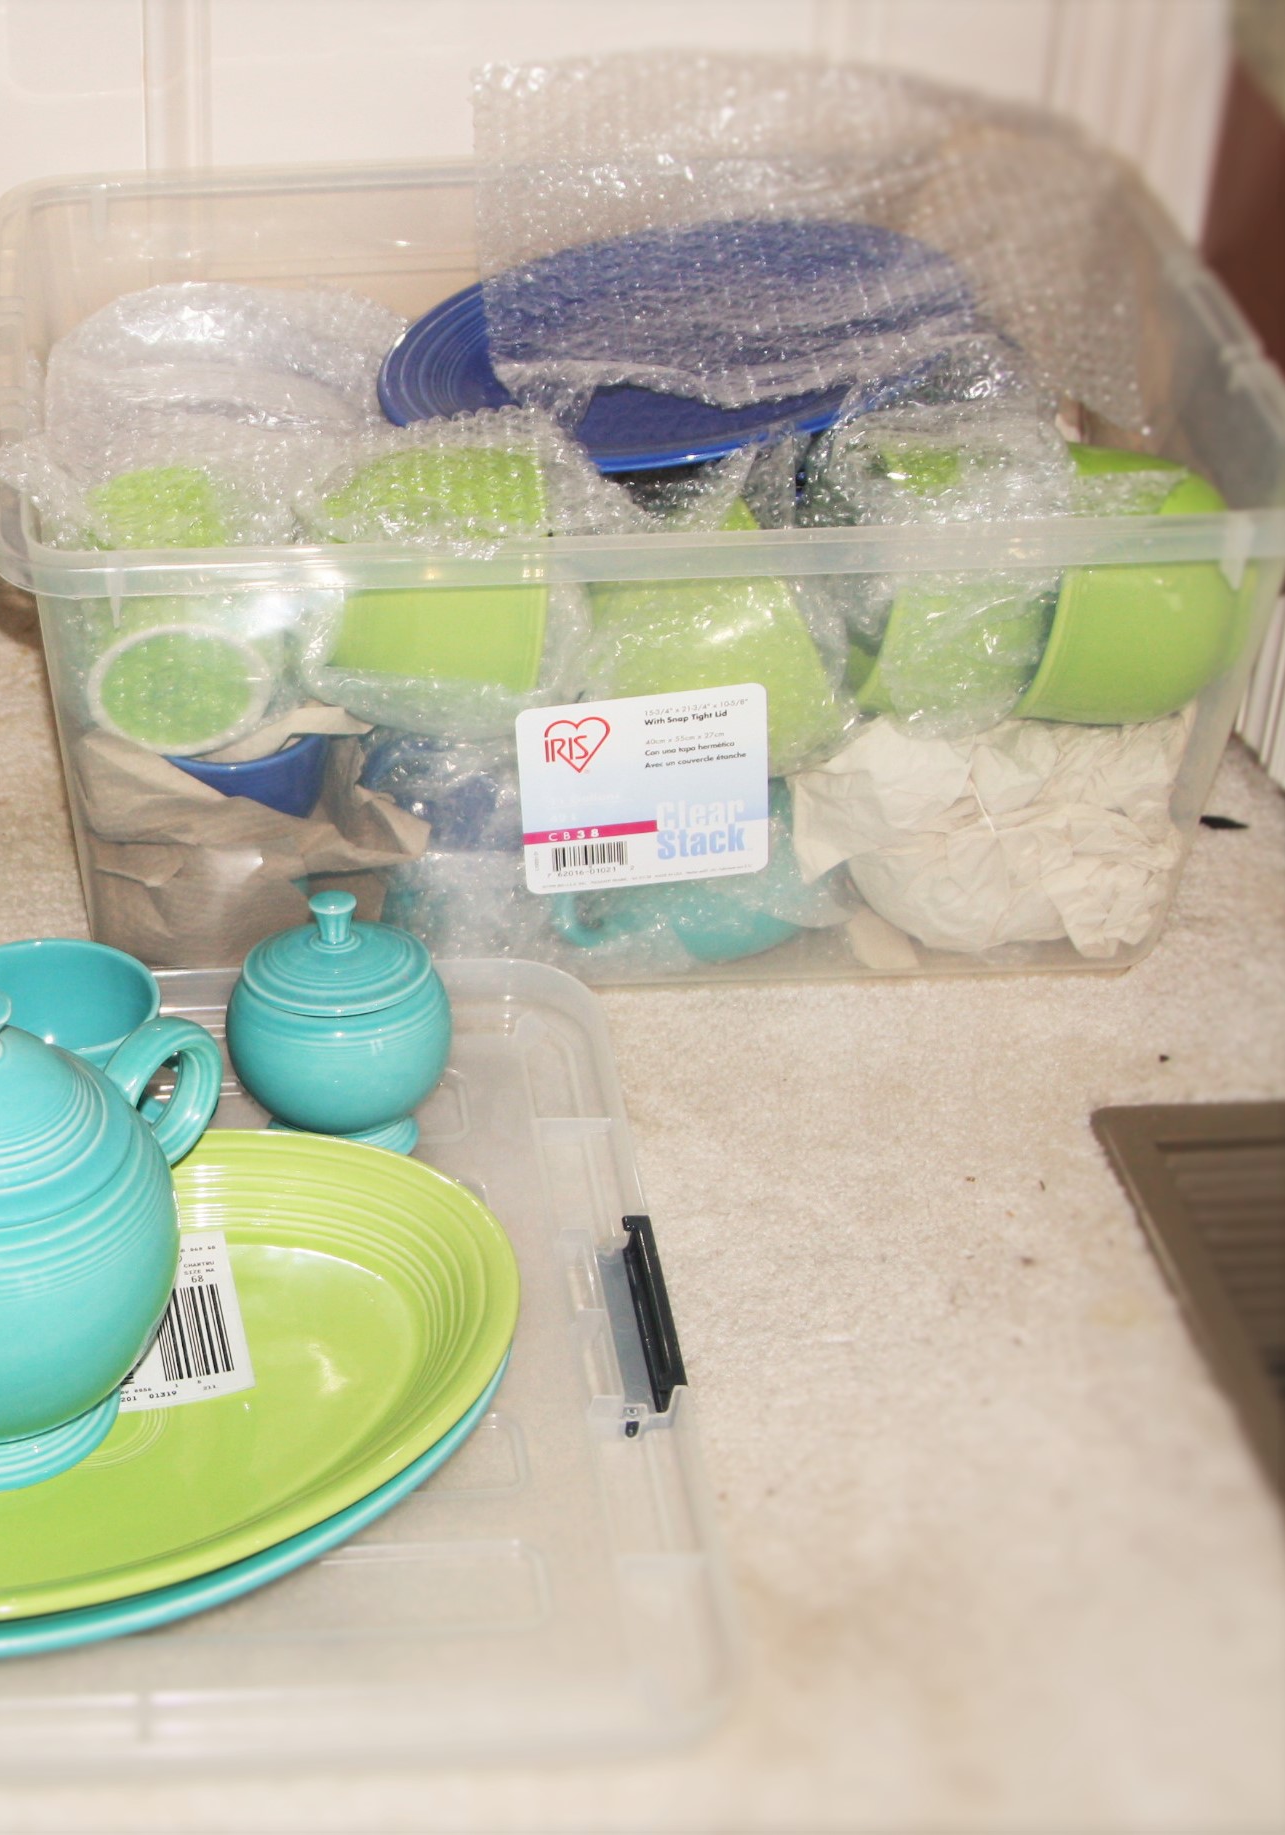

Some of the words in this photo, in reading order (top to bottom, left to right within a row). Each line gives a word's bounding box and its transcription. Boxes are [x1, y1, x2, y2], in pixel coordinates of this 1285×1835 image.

[644, 718, 665, 726] With
[667, 716, 688, 724] Snap
[691, 712, 712, 721] Tight
[715, 710, 728, 718] Lid
[544, 735, 589, 763] IRIS
[677, 755, 714, 765] couvercle
[716, 752, 747, 761] étanche
[656, 800, 745, 831] Clear
[657, 823, 745, 861] Stack
[191, 1275, 204, 1283] 68
[148, 1390, 177, 1399] 01319
